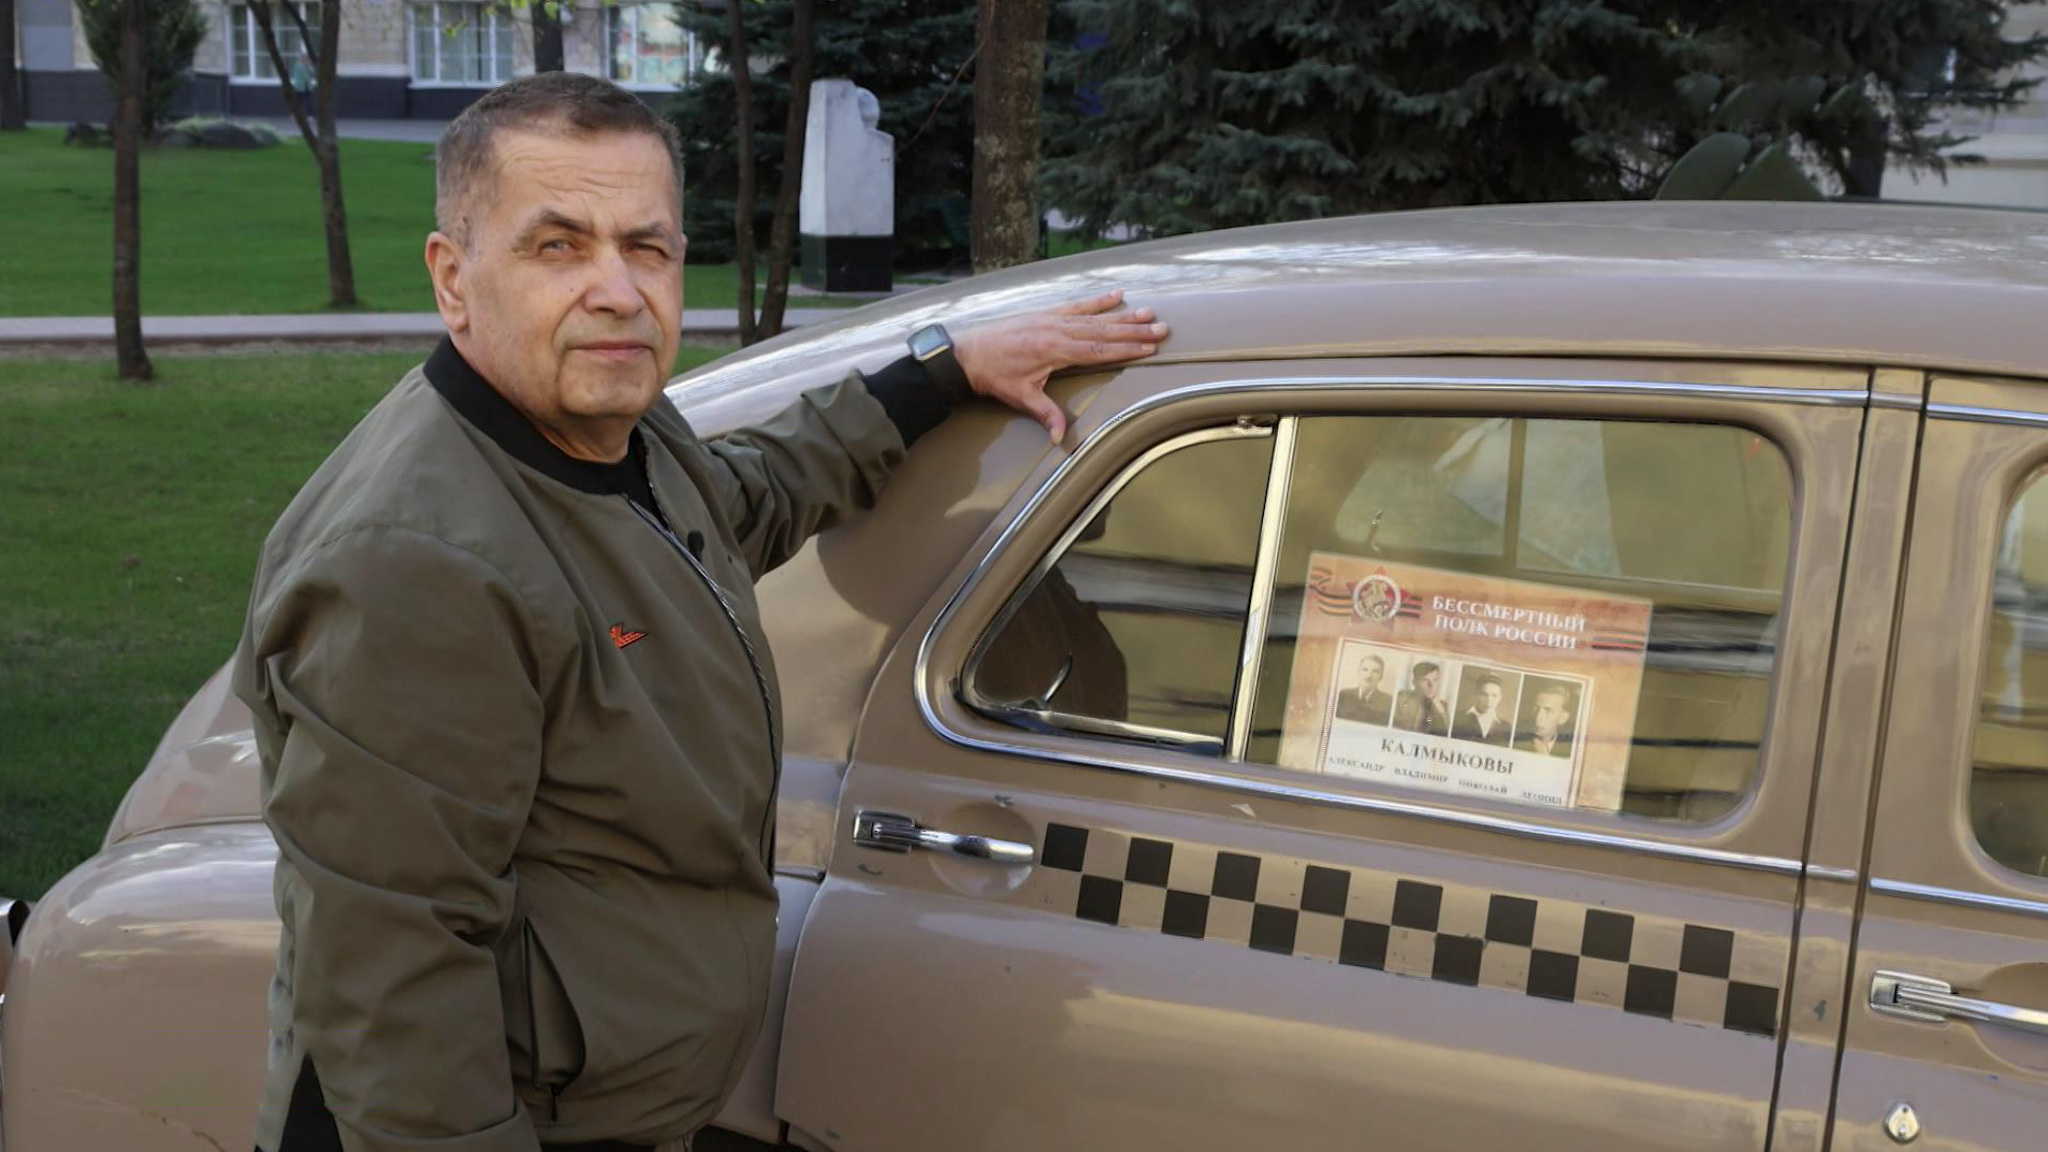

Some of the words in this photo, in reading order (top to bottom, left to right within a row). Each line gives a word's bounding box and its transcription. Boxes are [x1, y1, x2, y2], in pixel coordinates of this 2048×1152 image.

[1432, 596, 1586, 632] БЕССМЕРТНЫЙ
[1434, 614, 1490, 637] ПОЛК
[1494, 625, 1577, 650] РОССИИ
[1380, 738, 1514, 774] КАЛМЫКОВЫ
